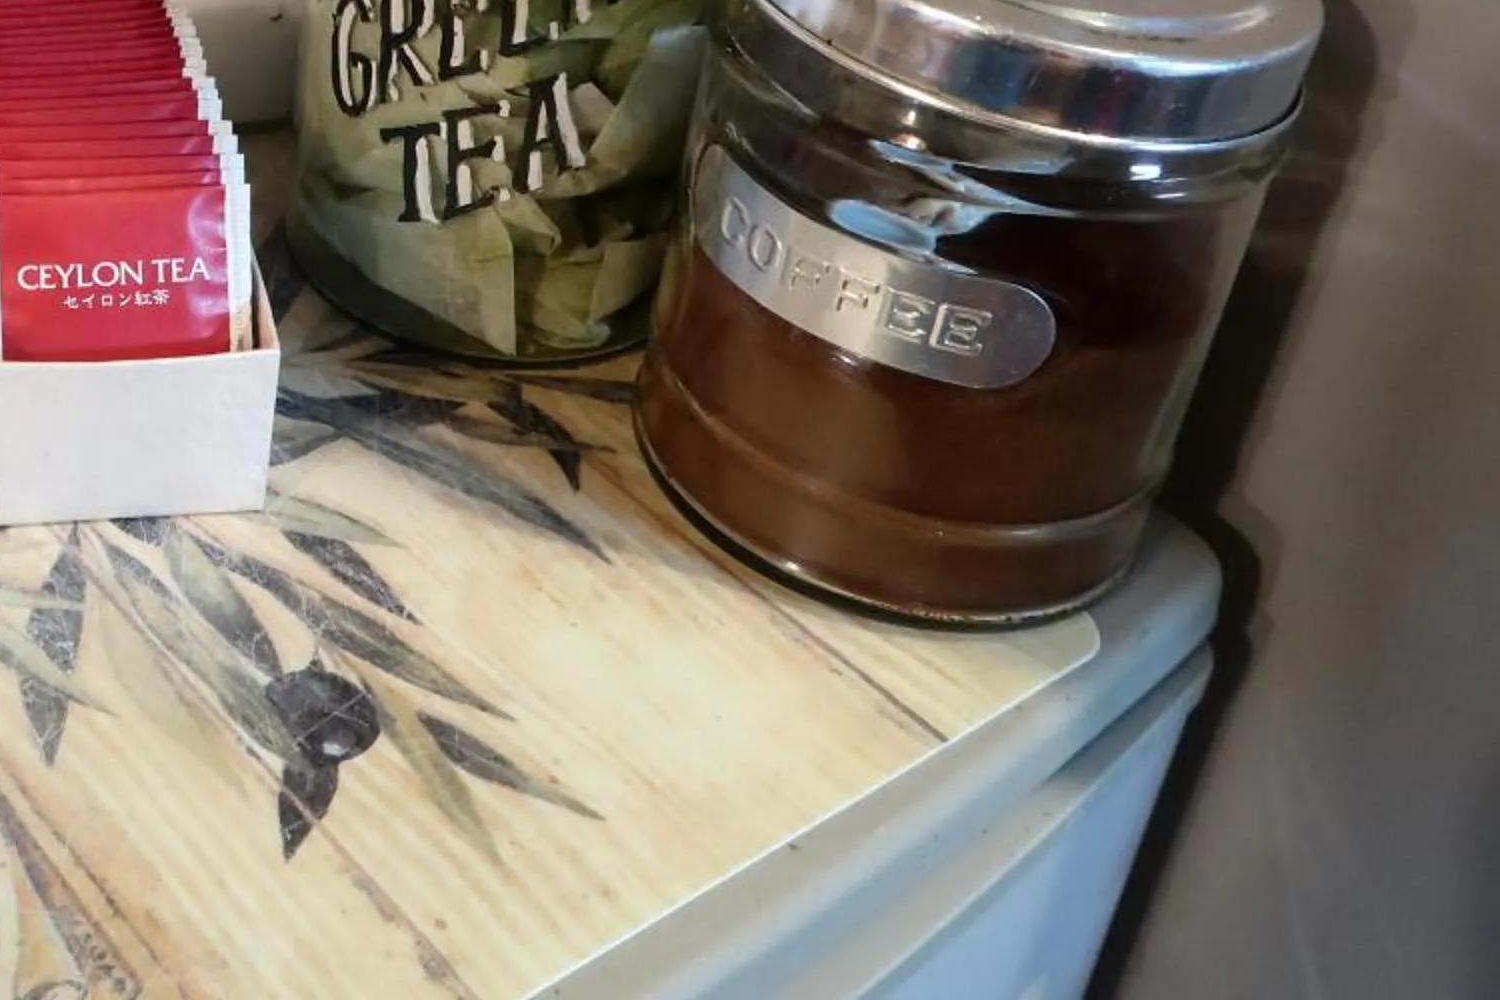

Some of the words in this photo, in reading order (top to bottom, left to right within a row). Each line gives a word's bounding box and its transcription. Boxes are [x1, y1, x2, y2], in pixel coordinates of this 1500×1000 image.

[379, 72, 587, 227] TEA
[17, 261, 144, 292] CEYLON
[151, 257, 212, 285] TEA
[63, 289, 171, 310] セイロン紅茶
[720, 196, 993, 358] COFFEE
